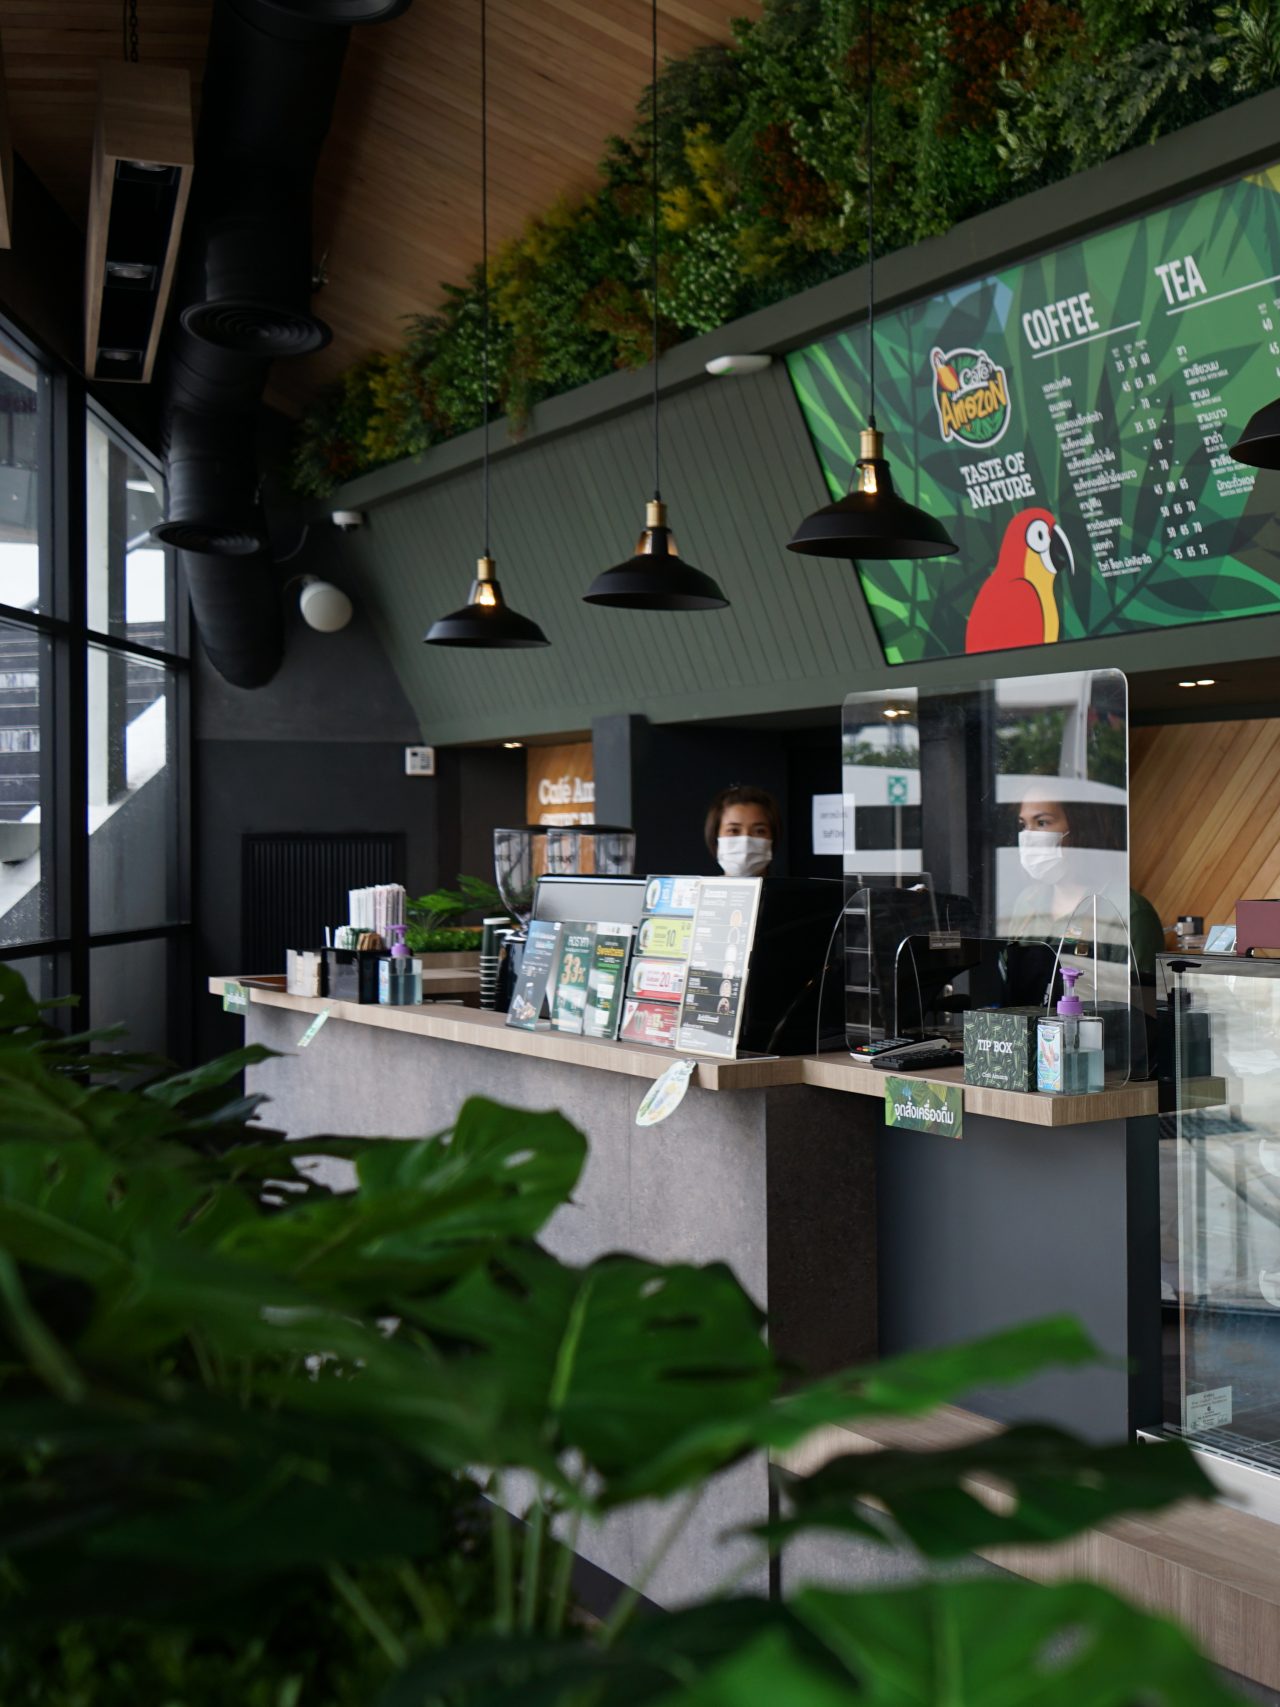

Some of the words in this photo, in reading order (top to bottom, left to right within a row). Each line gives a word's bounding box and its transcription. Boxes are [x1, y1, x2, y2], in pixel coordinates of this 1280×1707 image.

[1154, 255, 1208, 305] TEA
[1022, 292, 1099, 350] COFFEE
[1262, 318, 1272, 331] 40
[1270, 342, 1280, 354] 45
[1141, 397, 1150, 410] 70
[960, 458, 1005, 486] TASTE
[1005, 452, 1025, 474] OF
[1159, 459, 1169, 471] 70
[967, 473, 1036, 509] NATURE
[1186, 500, 1196, 512] 70
[1166, 526, 1176, 538] 50
[1193, 522, 1202, 533] 70
[1173, 548, 1183, 560] 55
[1186, 546, 1196, 557] 65
[1199, 544, 1208, 555] 75
[978, 1040, 992, 1051] TIP
[994, 1041, 1013, 1054] BOX
[894, 1096, 954, 1125] จุดสั่งเครื่องดื่ม
